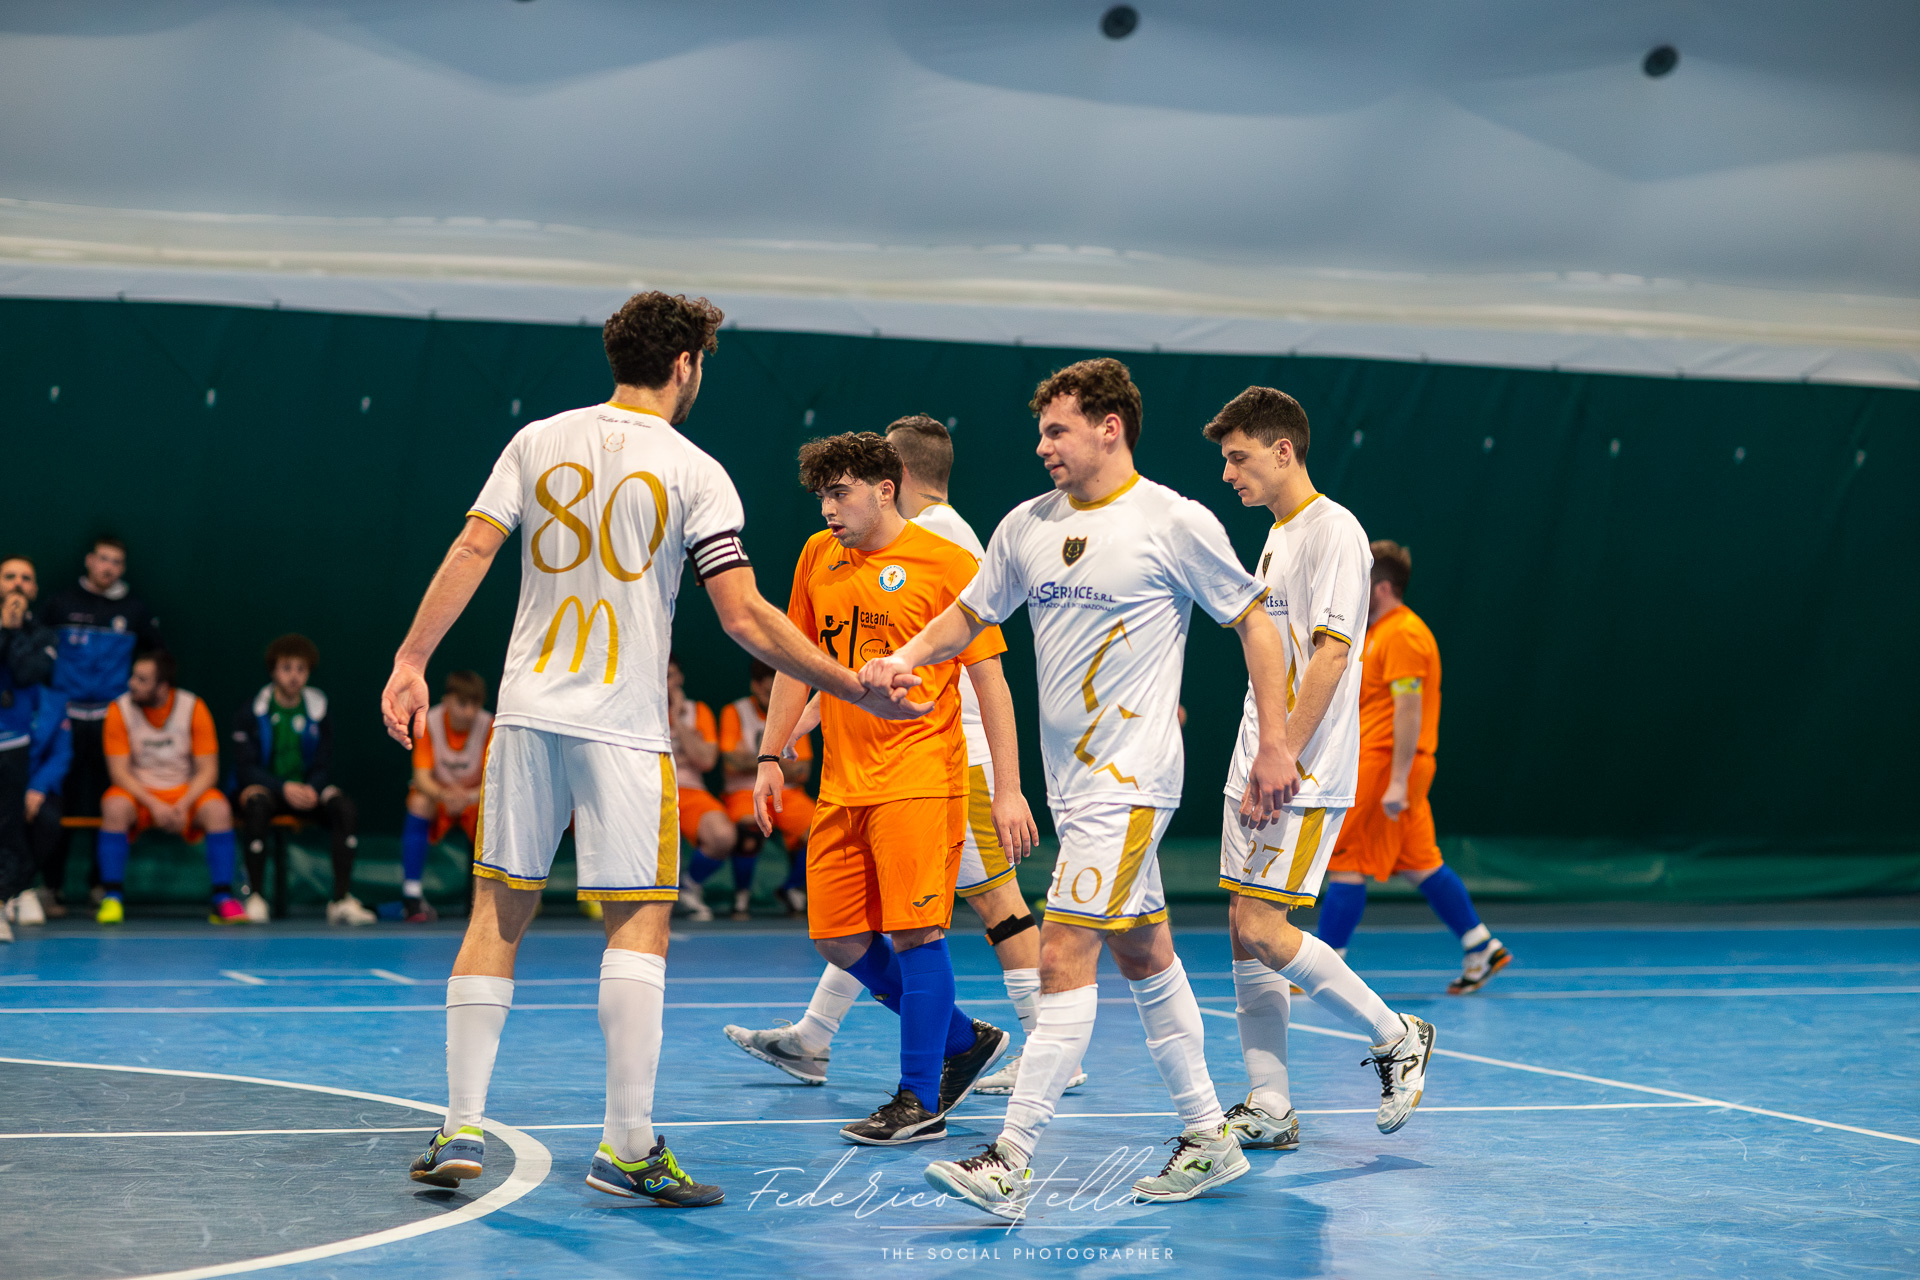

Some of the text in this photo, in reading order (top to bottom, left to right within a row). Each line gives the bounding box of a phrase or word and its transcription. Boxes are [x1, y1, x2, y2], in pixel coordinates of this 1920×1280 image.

[531, 461, 668, 582] 80
[860, 610, 889, 626] catani
[1242, 839, 1285, 879] 27
[1052, 860, 1102, 904] 10
